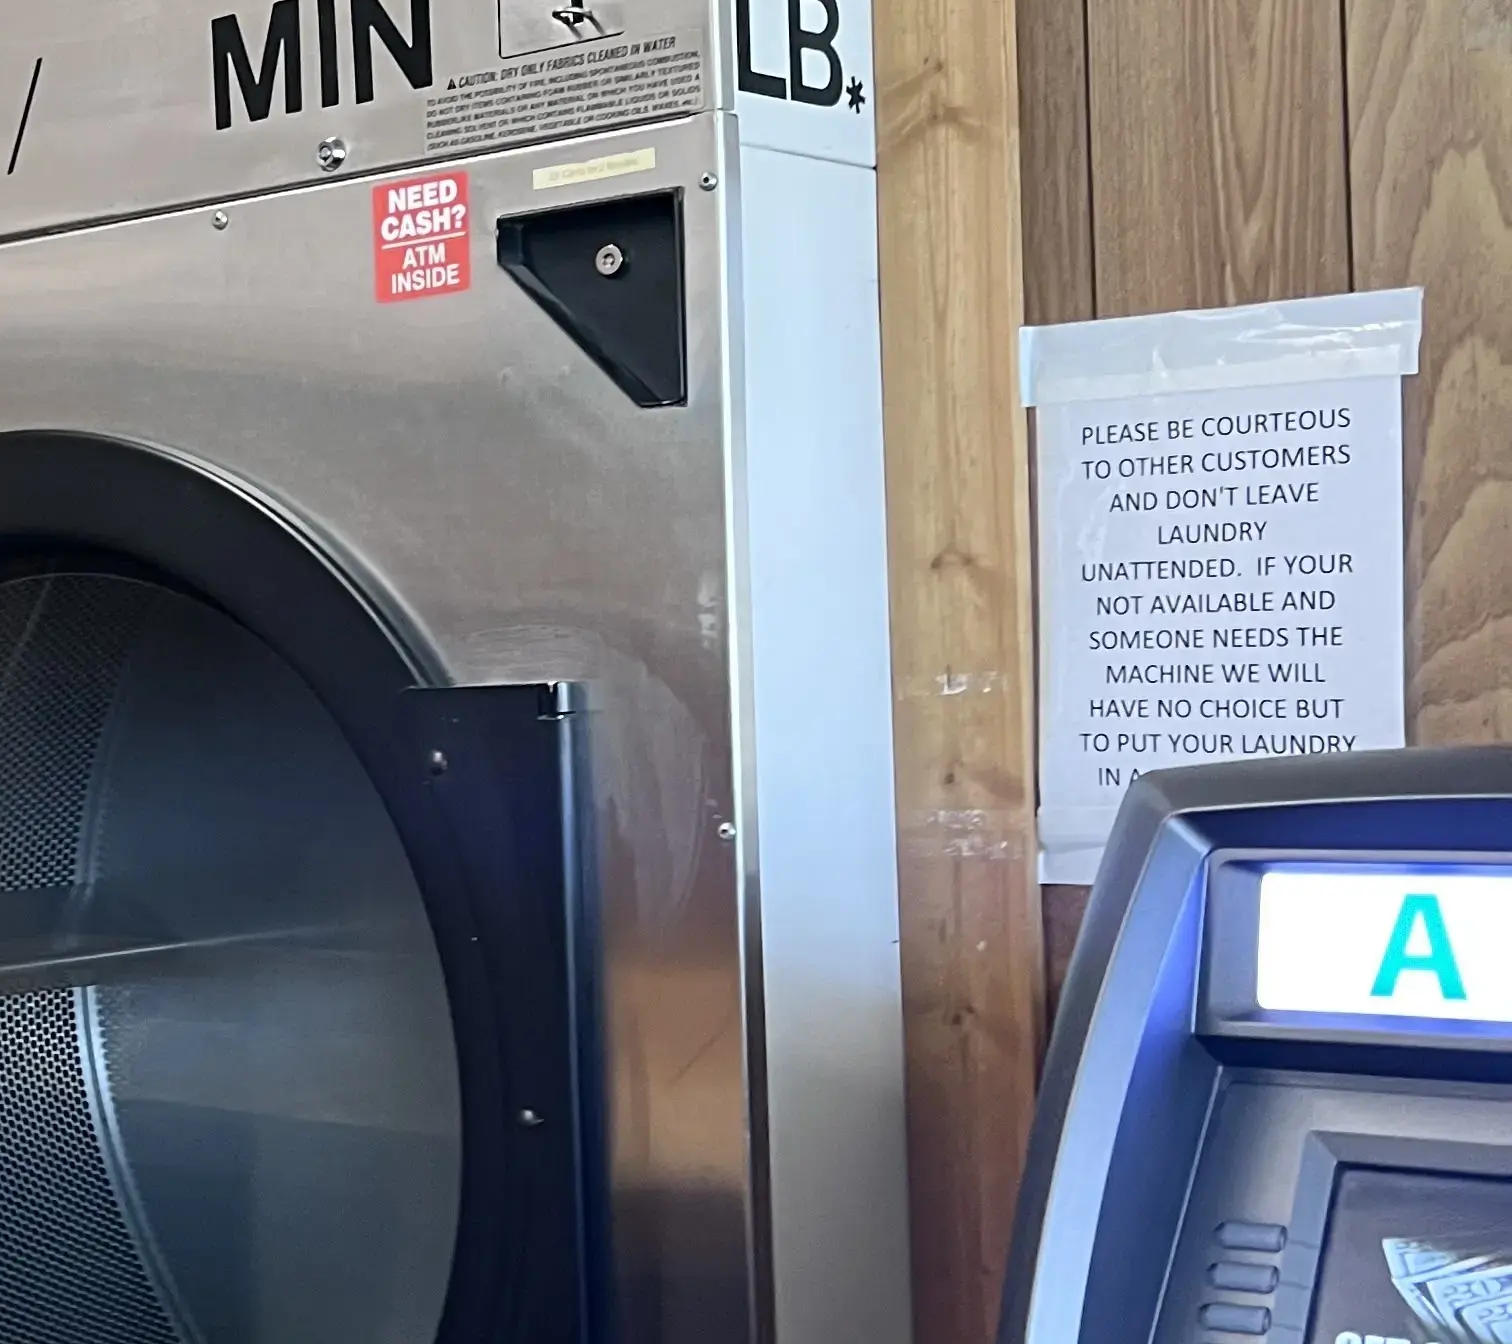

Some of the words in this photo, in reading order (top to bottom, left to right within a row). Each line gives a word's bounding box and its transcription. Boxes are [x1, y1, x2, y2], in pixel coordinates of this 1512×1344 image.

[643, 37, 675, 53] WATER
[7, 57, 43, 175] /
[388, 179, 458, 213] NEED
[380, 204, 466, 241] CASH?
[402, 242, 446, 270] ATM
[391, 263, 460, 294] INSIDE
[1082, 422, 1159, 445] PLEASE
[1168, 419, 1194, 439] BE
[1201, 408, 1351, 437] COURTEOUS
[1081, 460, 1111, 480] TO
[1118, 454, 1194, 477] OTHER
[1201, 444, 1351, 472] CUSTOMERS
[1109, 492, 1158, 512] AND
[1166, 487, 1238, 510] DON'T
[1246, 482, 1319, 505] LEAVE
[1158, 521, 1267, 544] LAUNDRY
[1082, 558, 1242, 582] UNATTENDED.
[1257, 557, 1276, 576] IF
[1284, 554, 1353, 575] YOUR
[1096, 596, 1144, 615] NOT
[1150, 592, 1274, 614] AVAILABLE
[1281, 590, 1335, 611] AND
[1089, 629, 1204, 649] SOMEONE
[1213, 627, 1288, 648] NEEDS
[1296, 627, 1343, 646] THE
[1106, 664, 1214, 684] MACHINE
[1221, 663, 1260, 683] WE
[1268, 663, 1326, 683] WILL
[1089, 699, 1149, 718] HAVE
[1158, 699, 1192, 718] NO
[1200, 699, 1287, 719] CHOICE
[1296, 699, 1345, 718] BUT
[1079, 733, 1110, 752] TO
[1117, 733, 1162, 753] PUT
[1168, 734, 1234, 754] YOUR
[1242, 735, 1357, 754] LAUNDRY
[1098, 767, 1120, 786] IN
[1369, 893, 1467, 1000] A
